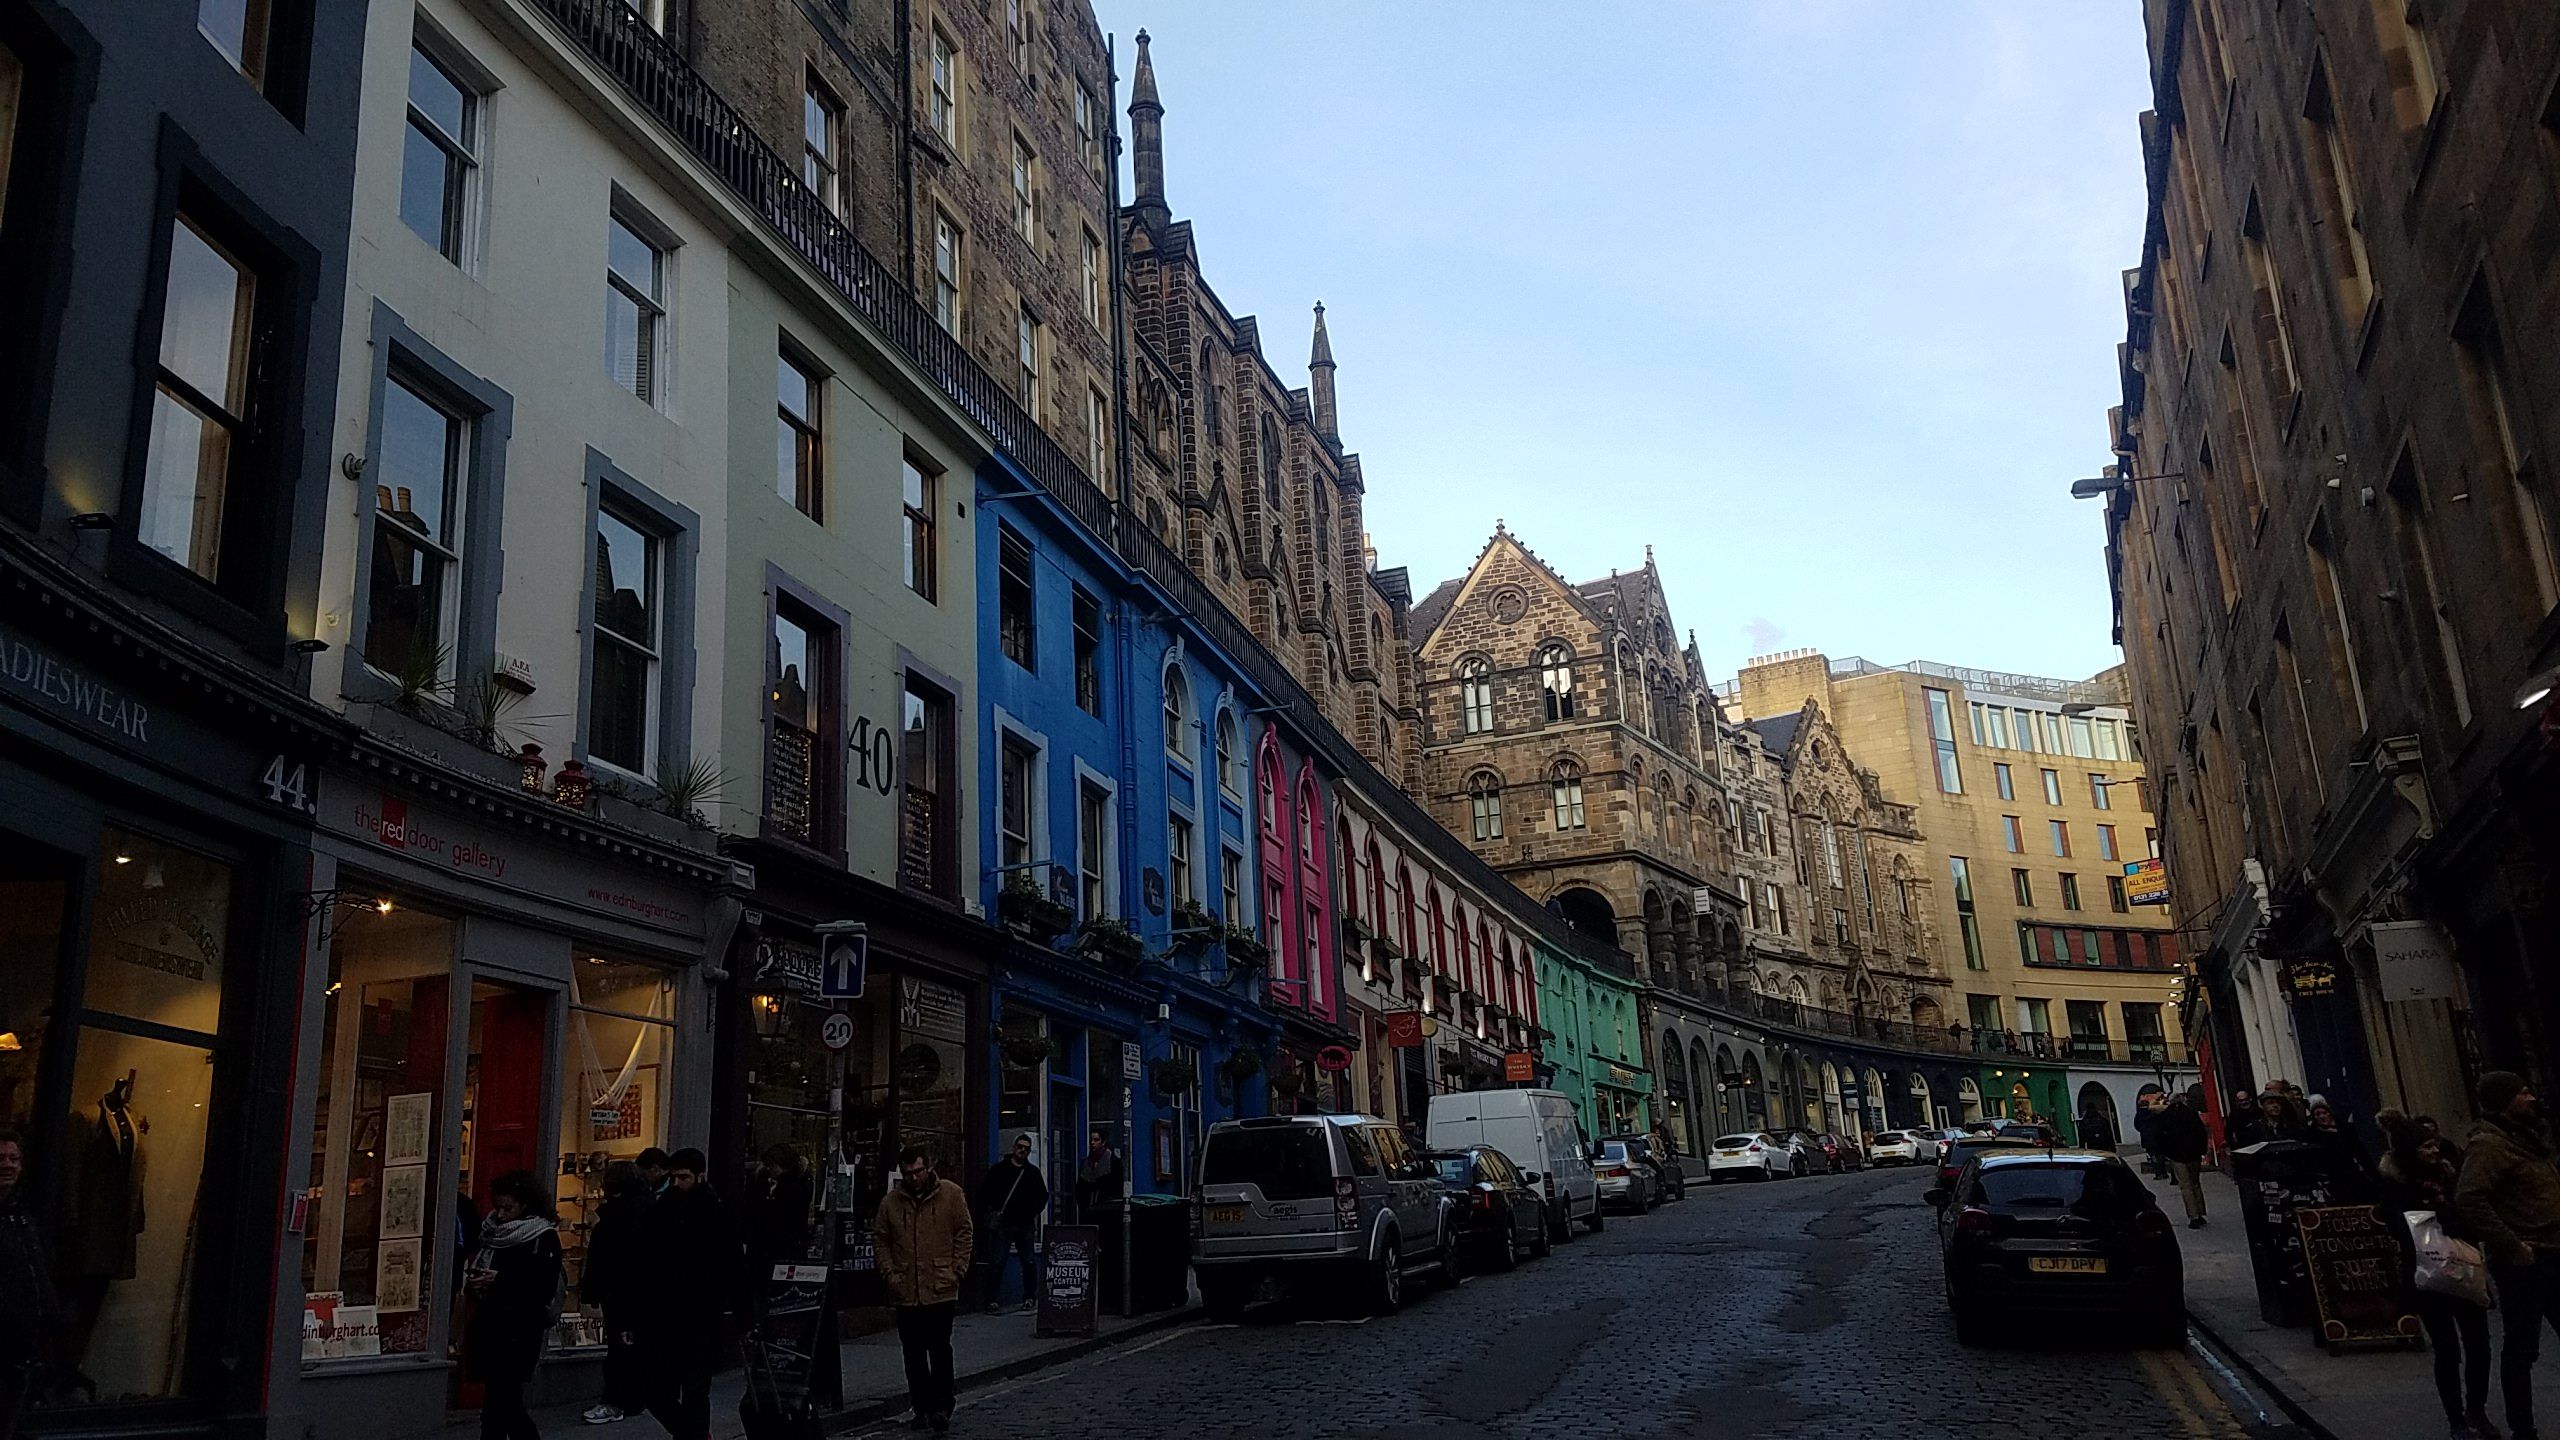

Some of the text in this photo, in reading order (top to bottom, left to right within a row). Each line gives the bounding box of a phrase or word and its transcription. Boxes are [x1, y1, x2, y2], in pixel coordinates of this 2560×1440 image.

[848, 715, 893, 797] 40
[354, 804, 506, 877] the red door gallery
[587, 887, 689, 923] www.edinburghart.com
[2385, 948, 2441, 962] SAHARA
[825, 1022, 851, 1041] 20
[1273, 1206, 1298, 1216] aegis
[1046, 1266, 1090, 1281] MUSEUM
